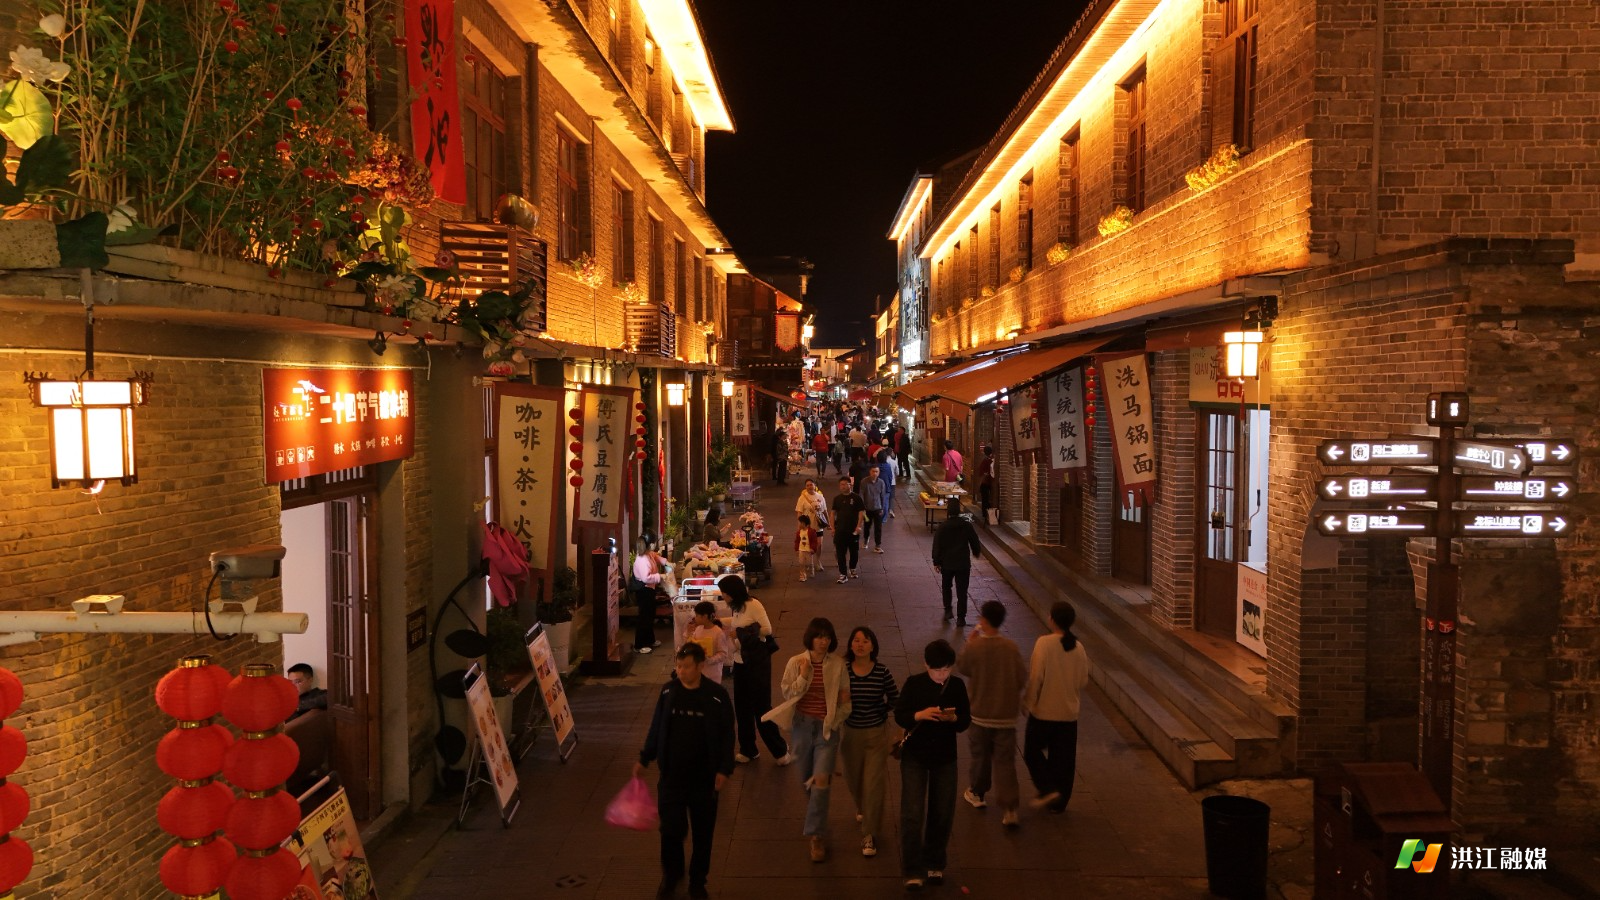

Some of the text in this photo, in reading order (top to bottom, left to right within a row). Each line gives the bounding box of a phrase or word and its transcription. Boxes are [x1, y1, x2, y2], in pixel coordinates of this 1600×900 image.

[590, 398, 617, 519] 傅氏豆腐乳
[1054, 373, 1079, 463] 传统散饭
[1115, 364, 1153, 475] 洗马锅面
